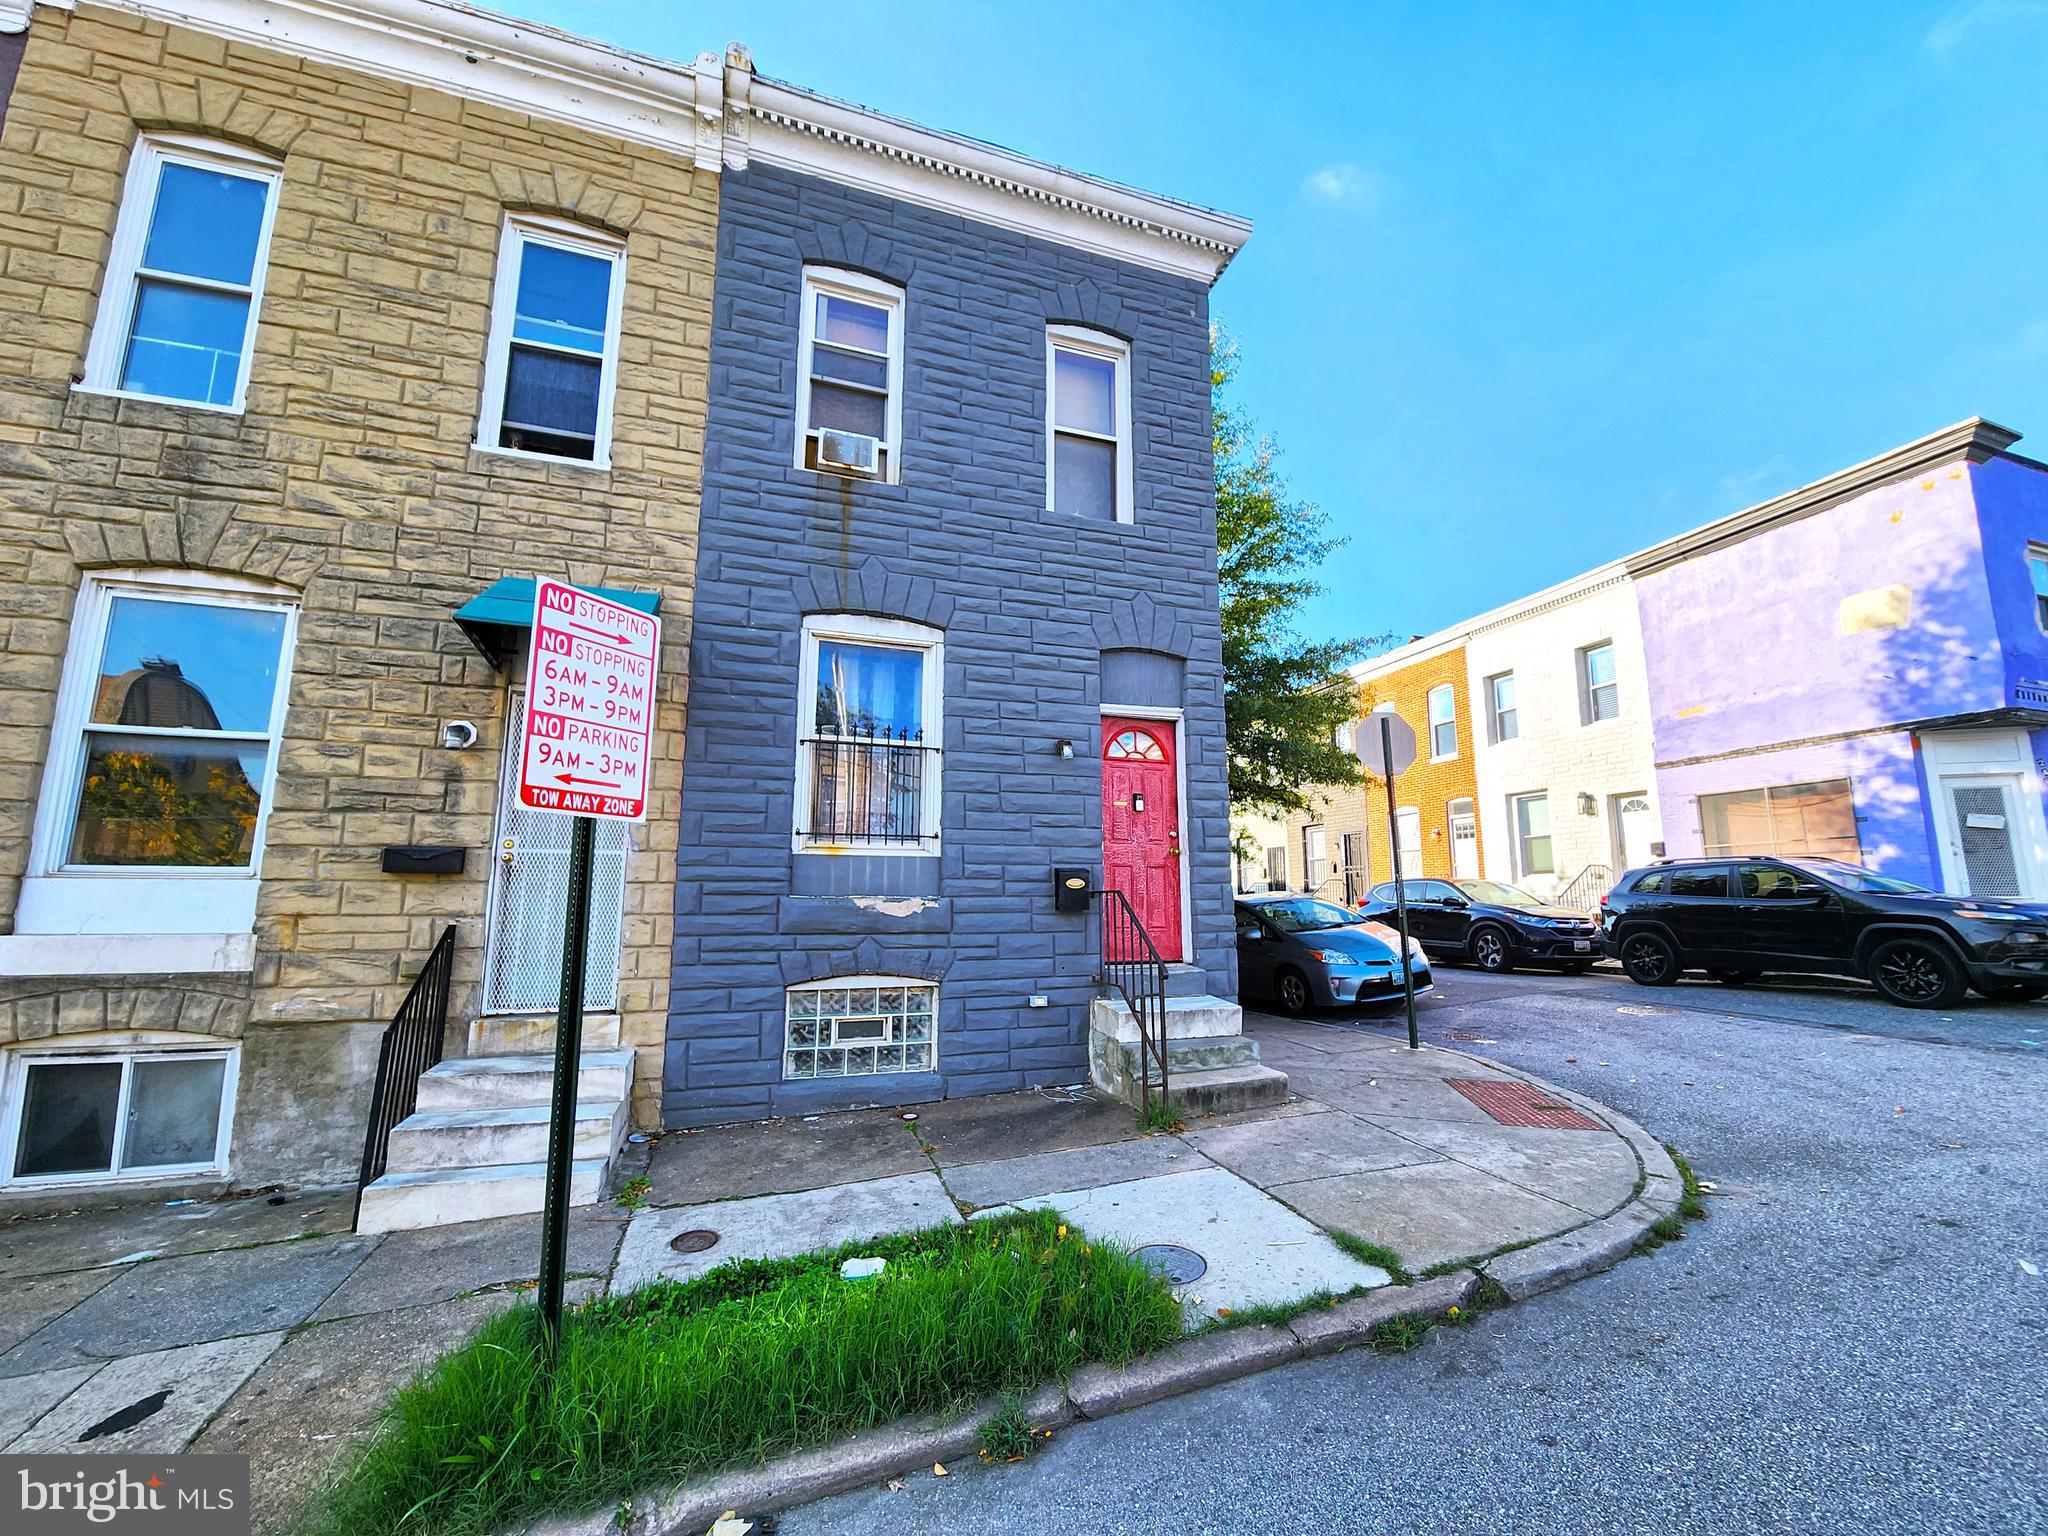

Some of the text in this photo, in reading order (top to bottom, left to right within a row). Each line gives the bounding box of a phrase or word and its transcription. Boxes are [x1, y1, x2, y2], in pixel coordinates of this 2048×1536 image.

[546, 587, 648, 637] NO STOPPING
[541, 629, 645, 678] NO STOPPING
[544, 659, 587, 688] 6AM
[606, 675, 643, 702] 9AM
[543, 686, 584, 713] 3PM
[605, 699, 641, 725] 9PM
[533, 714, 639, 753] NO PARKING
[538, 743, 580, 770] 9AM
[599, 754, 636, 779] 3PM
[532, 788, 635, 815] TOW AWAY ZONE
